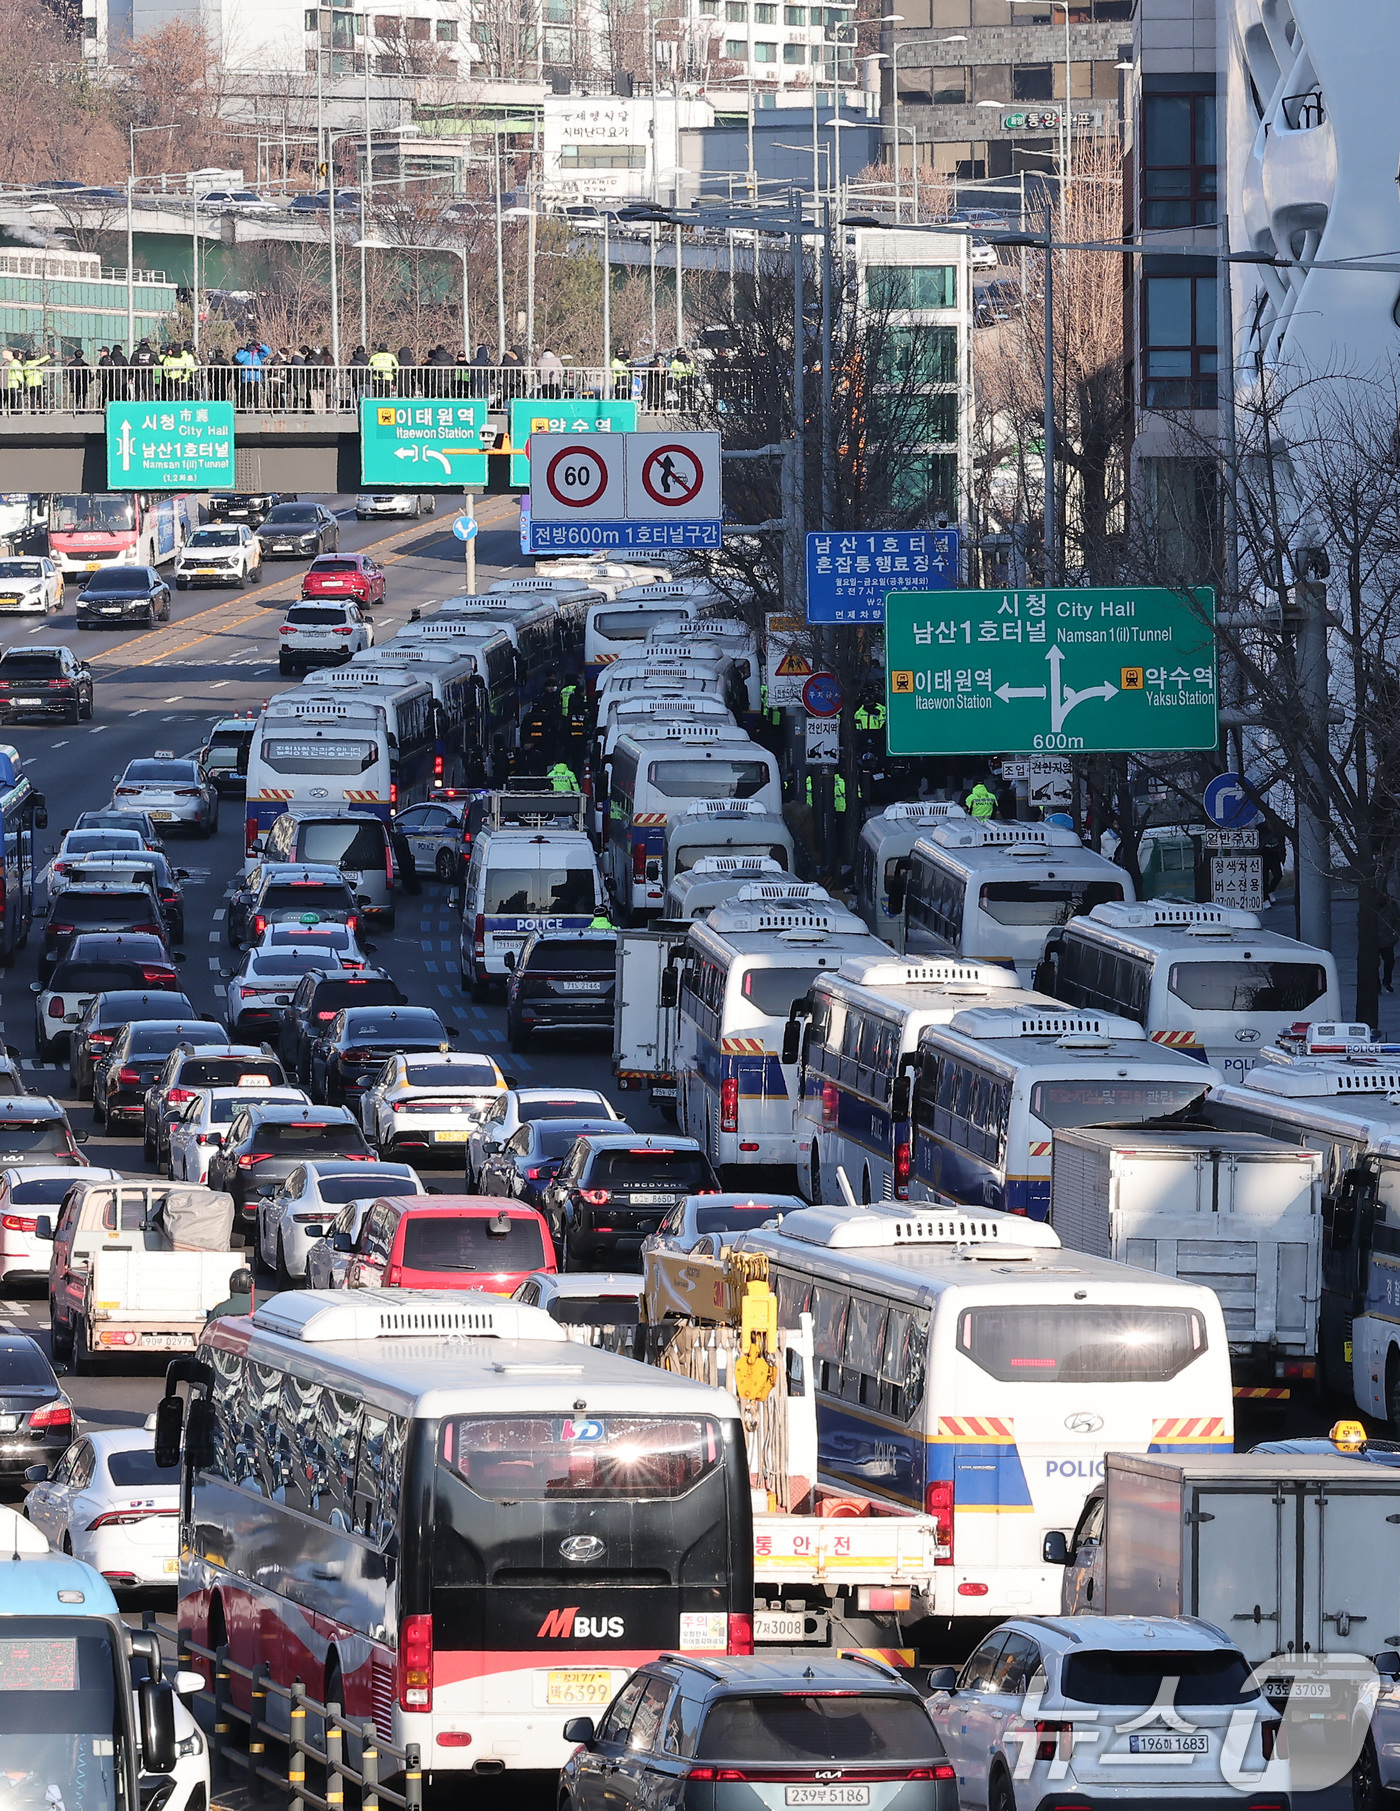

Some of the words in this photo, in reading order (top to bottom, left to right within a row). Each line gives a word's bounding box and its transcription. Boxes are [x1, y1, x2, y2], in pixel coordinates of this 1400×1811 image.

[142, 414, 176, 431] 시청
[396, 407, 475, 426] 이태원역
[178, 425, 203, 438] City
[207, 426, 228, 436] Hall
[396, 426, 437, 439] Itaewon
[438, 426, 475, 439] Station
[550, 418, 612, 432] 약수역
[142, 442, 229, 459] 남산1호터널
[142, 460, 180, 469] Namsan
[198, 459, 229, 468] Tunnel
[564, 466, 590, 486] 60
[535, 526, 620, 544] 전방600m
[626, 524, 718, 544] 1호터널구간
[816, 555, 949, 574] 혼잡통행료징수
[997, 594, 1046, 618] 시청
[1056, 602, 1093, 620] City
[1100, 602, 1136, 616] Hall
[836, 610, 882, 620] 면제차량
[913, 619, 1047, 644] 남산1호터널
[1057, 627, 1106, 643] Namsan
[1132, 626, 1172, 642] Tunnel
[915, 668, 992, 693] 이태원역
[1146, 666, 1213, 690] 약수역
[916, 695, 955, 710] Itaewon
[956, 694, 992, 709] Station
[1146, 690, 1178, 707] Yaksu
[1178, 690, 1214, 706] Station
[808, 722, 838, 735] 견인지역
[1033, 734, 1084, 749] 600m
[1032, 761, 1072, 774] 견인지역
[1215, 860, 1260, 874] 청색차선
[1215, 878, 1260, 892] 버스전용
[516, 918, 563, 930] POLICE
[1347, 1044, 1380, 1054] POLICE
[1046, 1460, 1104, 1478] POLIC
[537, 1606, 624, 1638] MBUS
[682, 1616, 708, 1628] 주의
[1295, 1684, 1324, 1696] 3709
[1176, 1738, 1206, 1750] 1683
[814, 1770, 842, 1779] KIA
[829, 1788, 865, 1804] 5186
